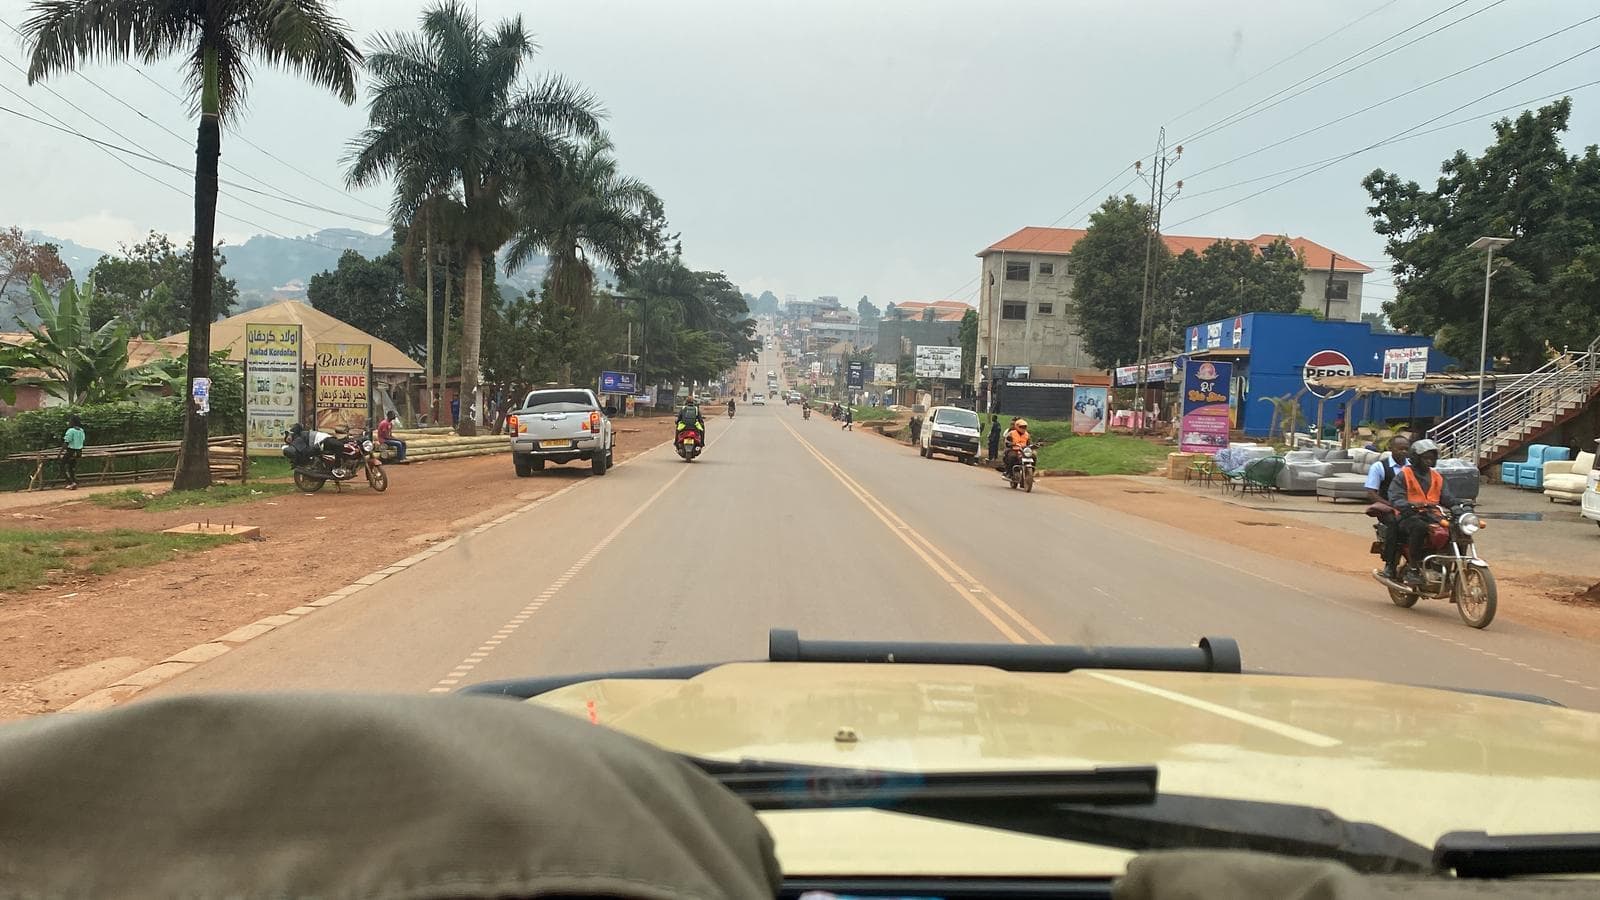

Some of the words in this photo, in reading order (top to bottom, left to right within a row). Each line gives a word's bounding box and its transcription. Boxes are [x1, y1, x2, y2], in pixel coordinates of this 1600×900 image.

[249, 348, 268, 356] Awlad
[269, 348, 297, 357] Kordofan
[317, 352, 368, 370] Bakery
[1306, 368, 1351, 378] PEPSI
[320, 375, 366, 387] KITENDE
